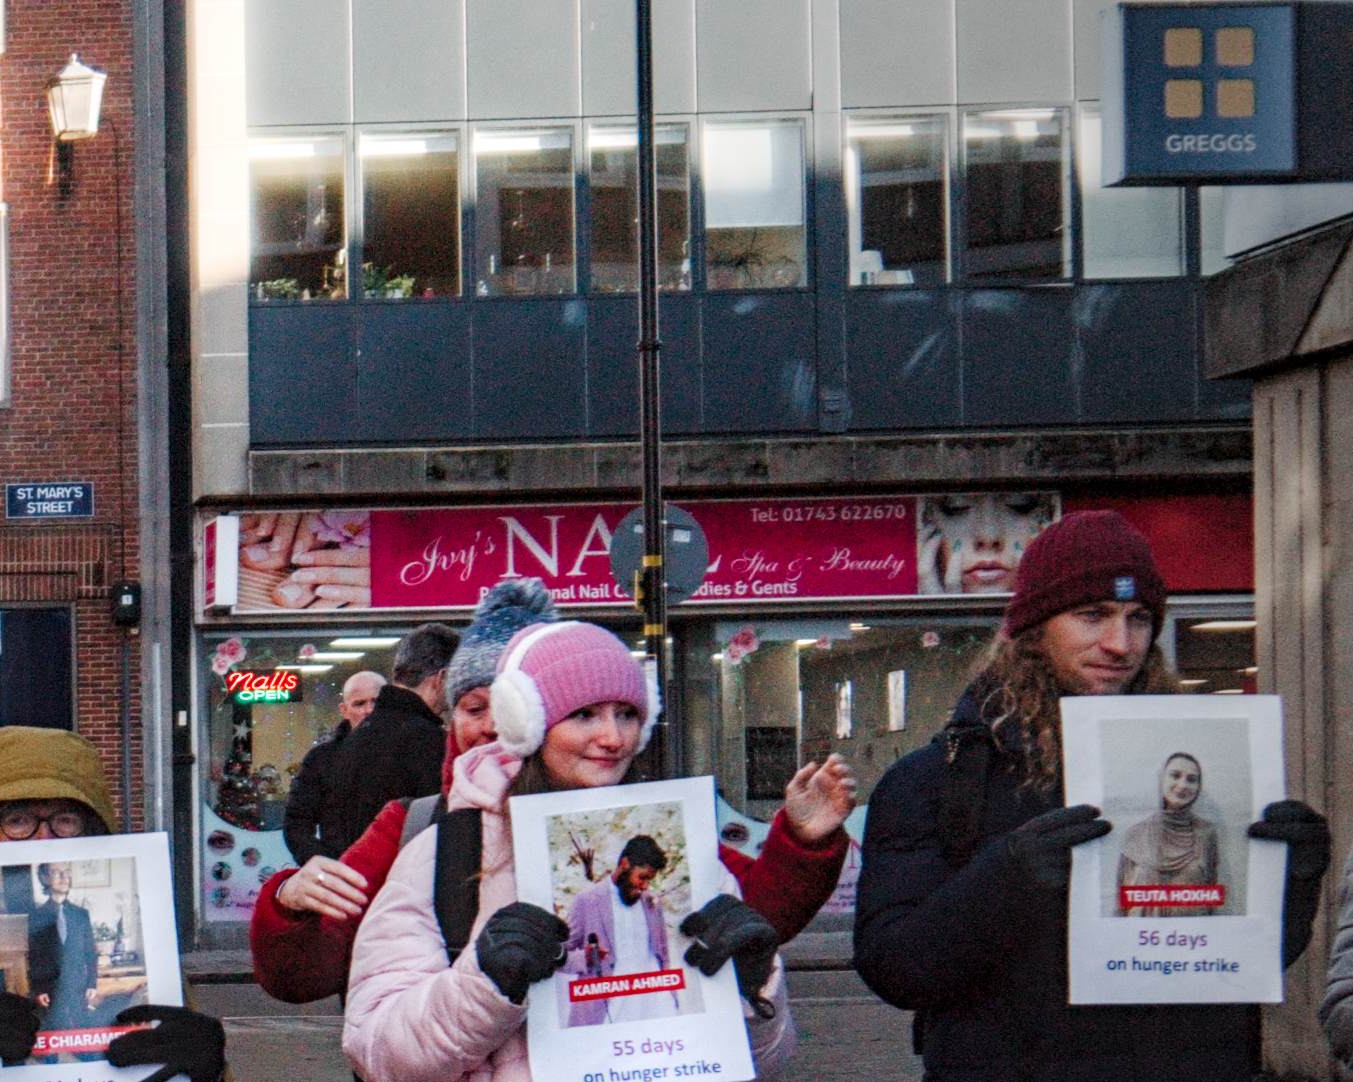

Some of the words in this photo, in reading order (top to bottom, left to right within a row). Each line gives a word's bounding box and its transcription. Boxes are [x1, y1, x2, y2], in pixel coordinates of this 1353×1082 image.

[1165, 134, 1257, 152] GREGGS
[36, 486, 84, 499] MARY'S
[26, 501, 74, 514] STREET
[750, 507, 779, 522] Tel:
[782, 506, 836, 521] 01743
[840, 504, 906, 520] 622670
[400, 530, 496, 586] Ivy's
[730, 550, 779, 581] Spa
[819, 547, 906, 580] Beauty
[579, 583, 611, 599] Nail
[735, 581, 748, 595] &
[751, 580, 798, 595] Gents
[239, 689, 289, 701] OPEN
[1125, 889, 1168, 903] TEUTA
[1170, 889, 1220, 902] HOXHA
[1138, 930, 1161, 946] 56
[1166, 930, 1208, 950] days
[1106, 958, 1127, 971] on
[1132, 956, 1188, 975] hunger
[1193, 958, 1240, 973] strike
[573, 980, 630, 997] KAMRAN
[632, 974, 681, 990] AHMED
[49, 1031, 127, 1048] CHIARAM
[612, 1040, 635, 1057] 55
[641, 1038, 685, 1057] days
[609, 1067, 668, 1082] hunger
[674, 1060, 722, 1077] strike
